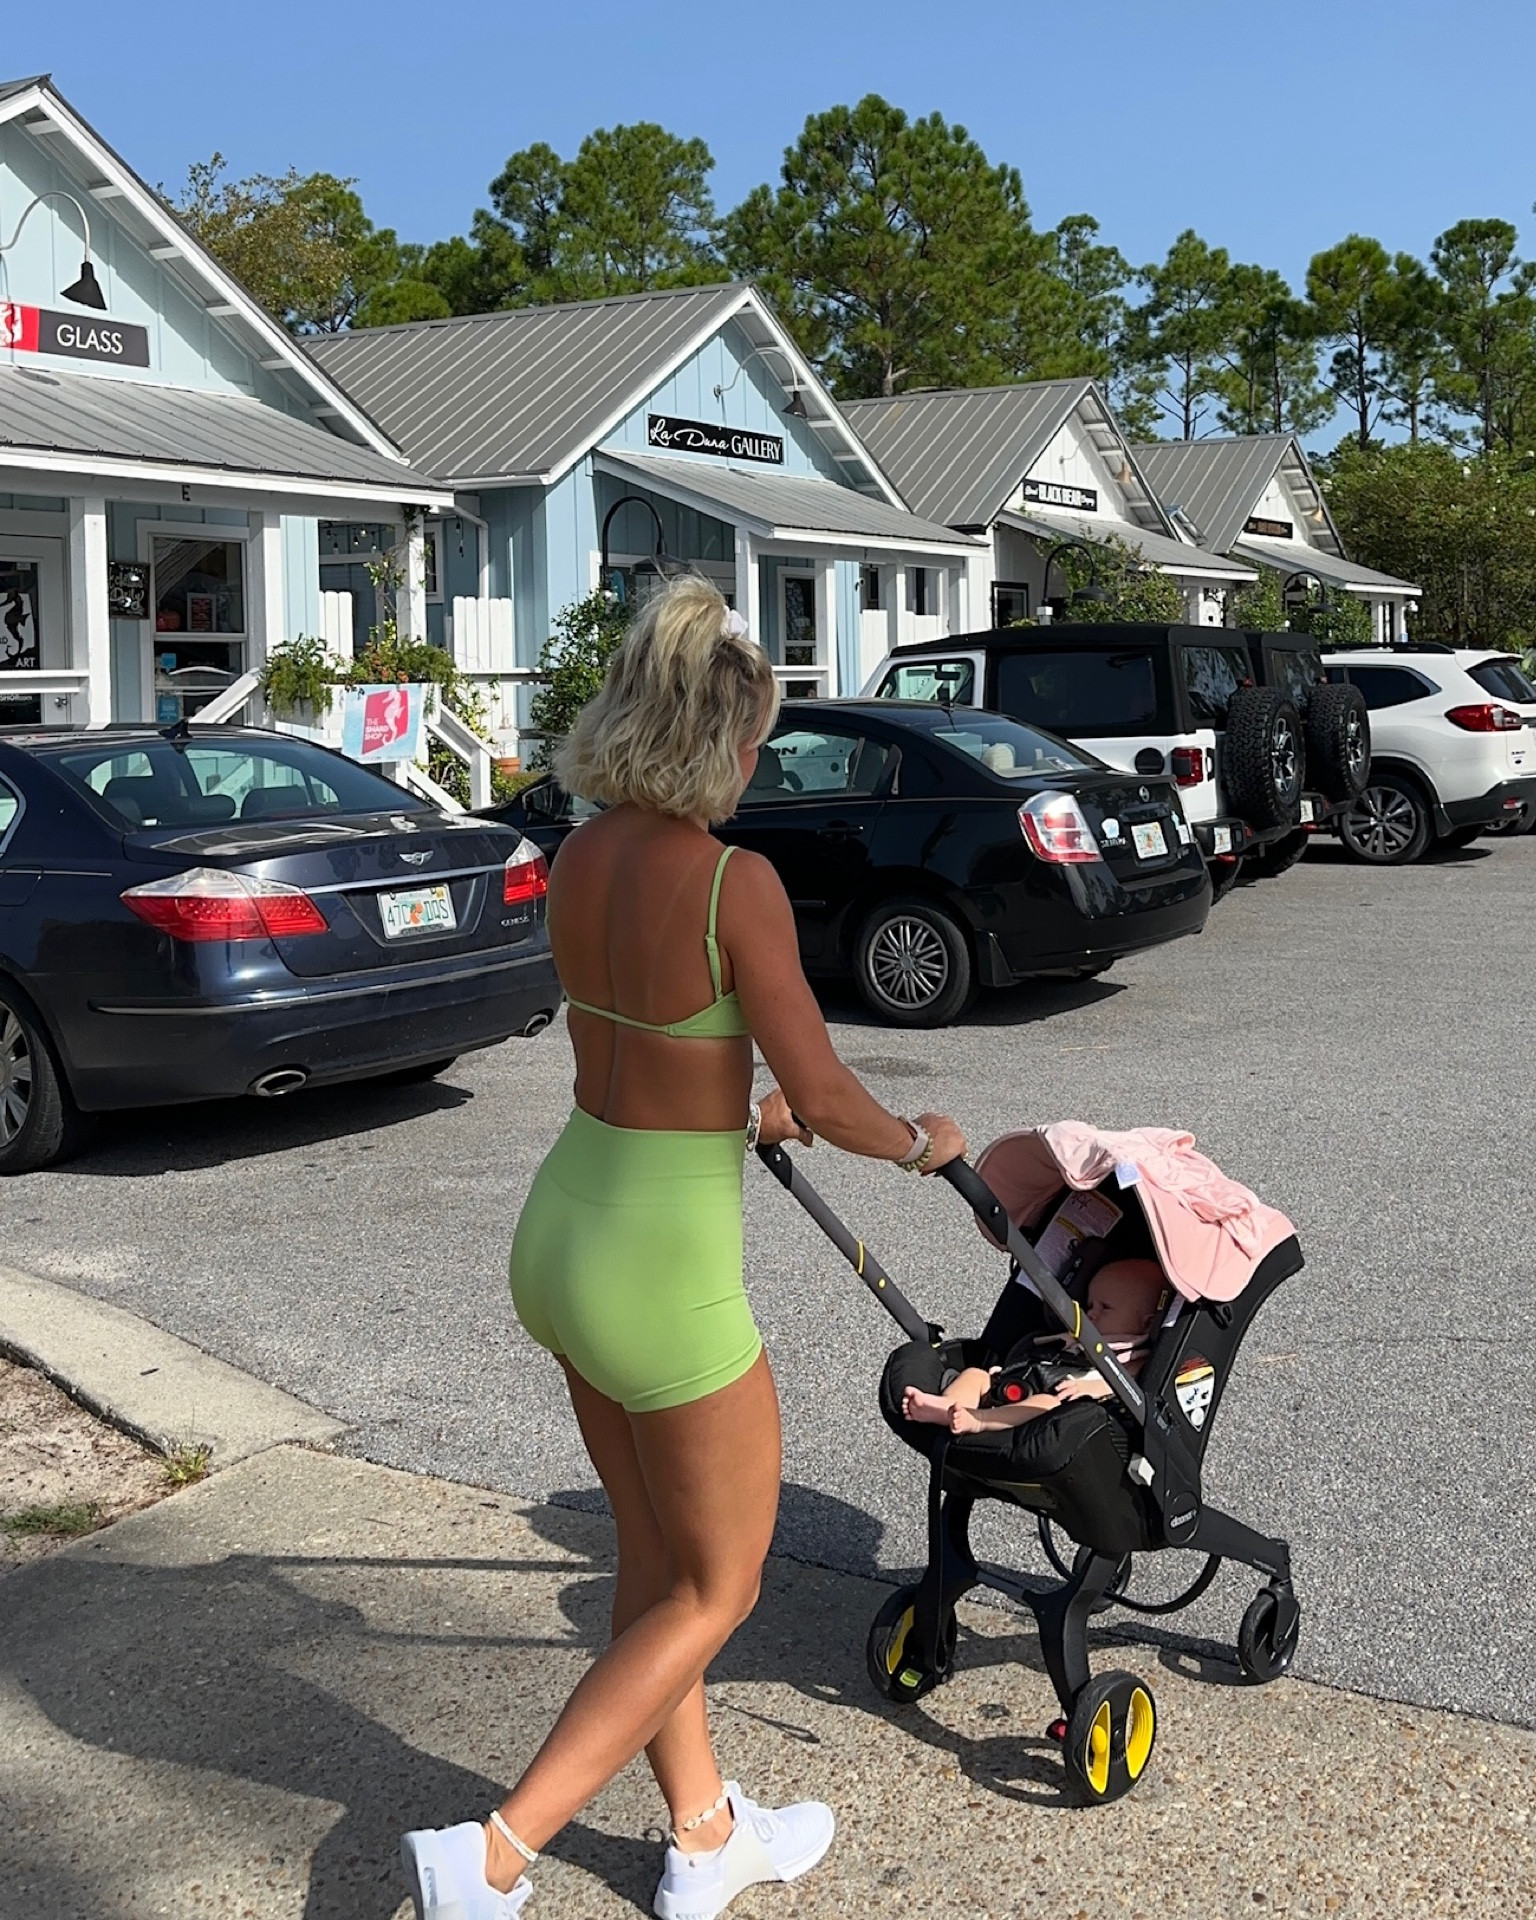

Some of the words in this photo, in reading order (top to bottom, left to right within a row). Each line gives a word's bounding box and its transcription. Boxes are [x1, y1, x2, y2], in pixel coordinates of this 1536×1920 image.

[57, 323, 123, 354] GLASS
[650, 418, 674, 446] La
[731, 435, 781, 460] GALLERY
[182, 484, 191, 501] E
[15, 657, 36, 668] ART
[364, 732, 383, 741] SHOP
